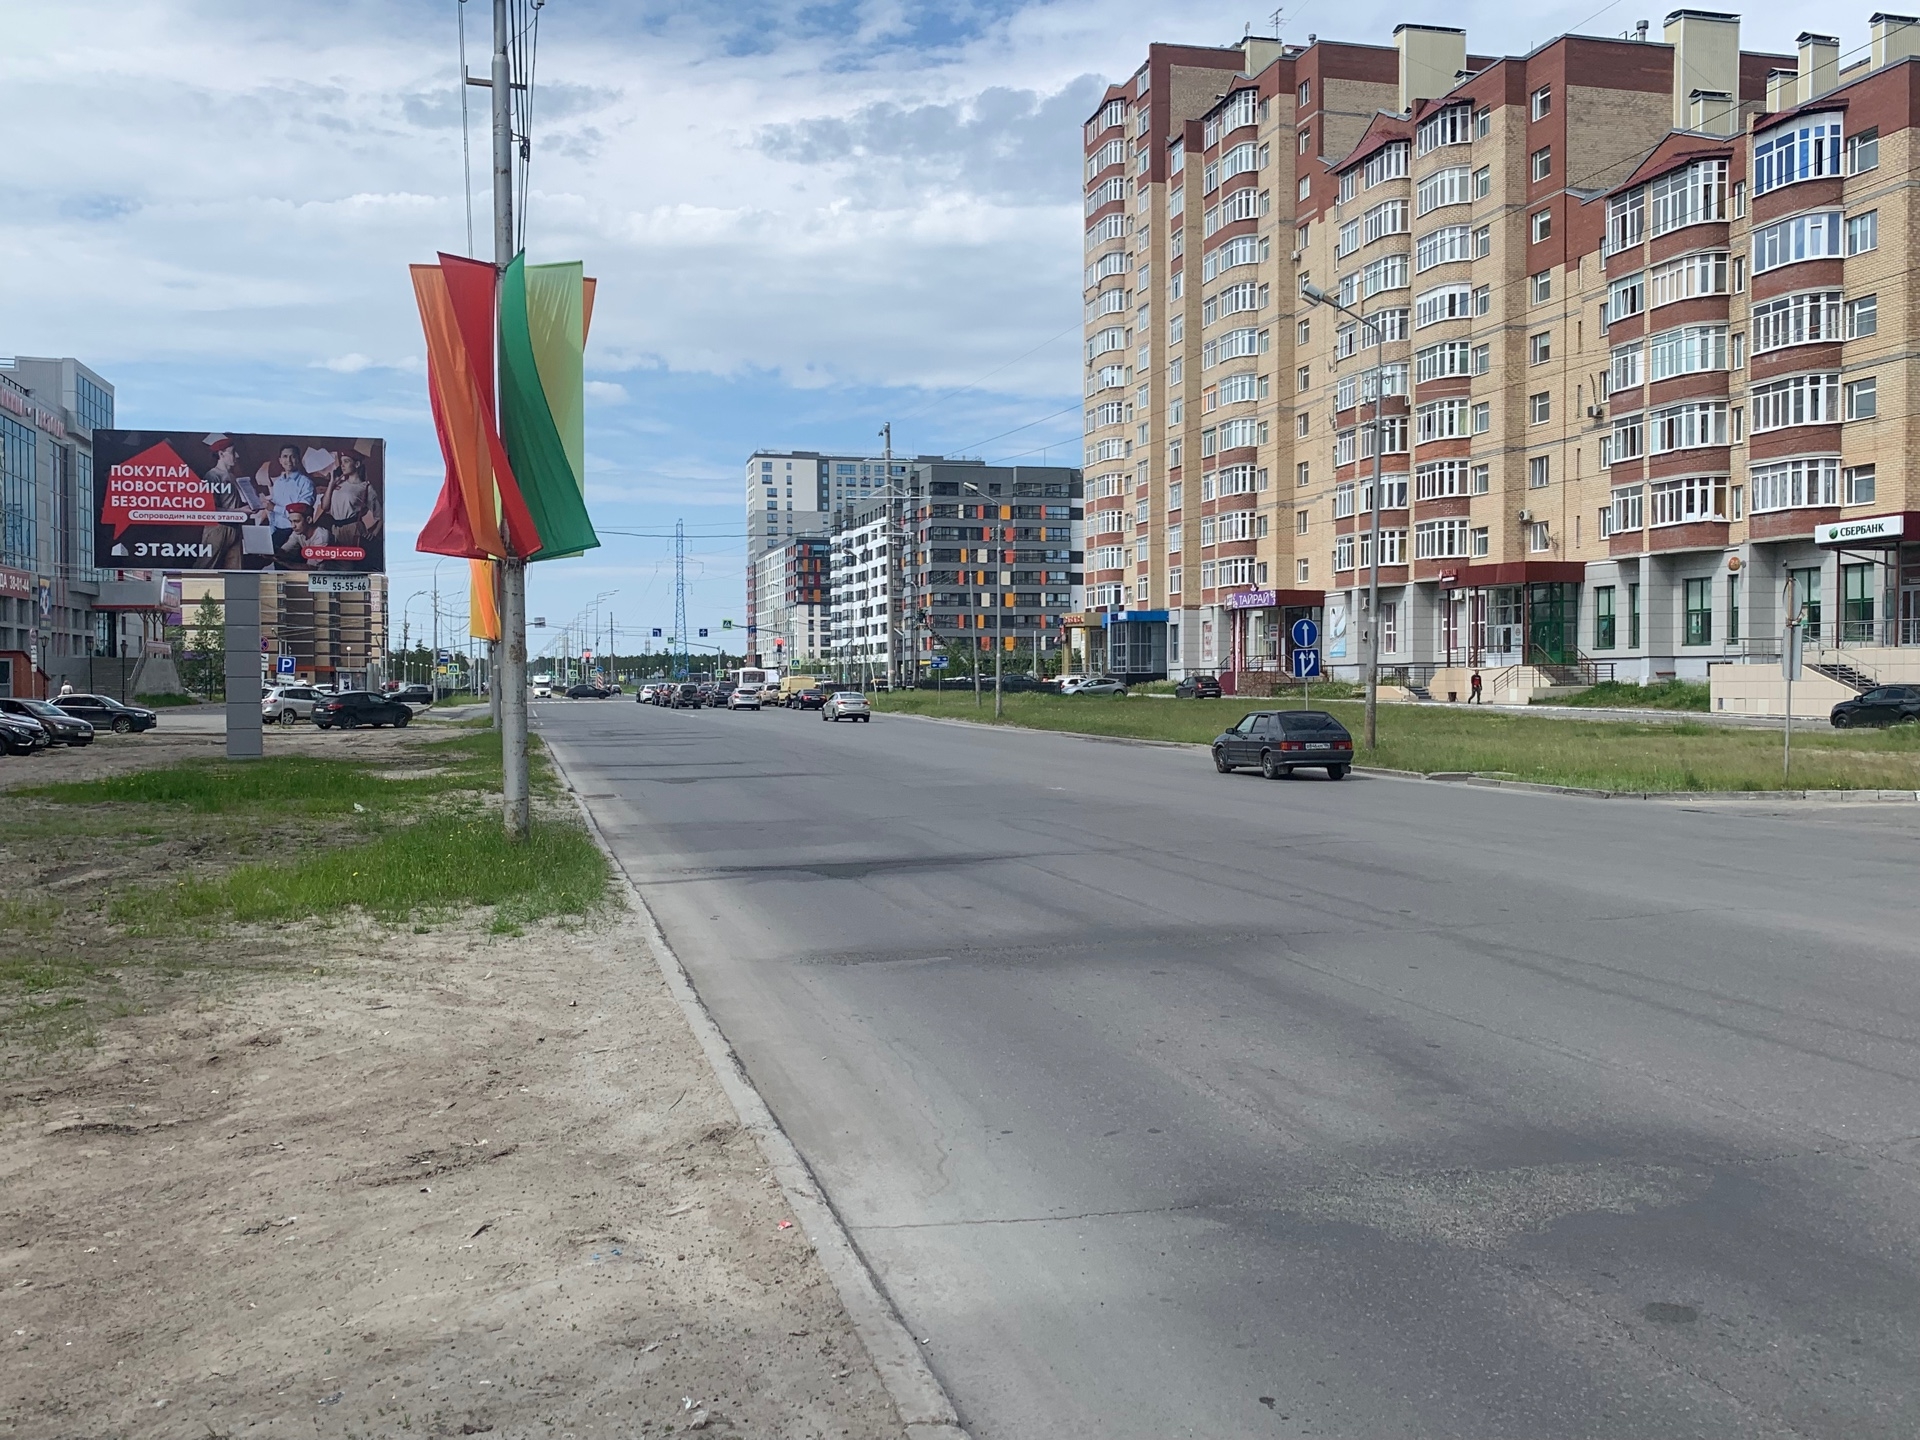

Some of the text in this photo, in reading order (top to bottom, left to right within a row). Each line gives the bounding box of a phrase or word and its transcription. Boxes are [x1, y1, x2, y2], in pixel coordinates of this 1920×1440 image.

[110, 464, 190, 478] ПОКУПАЙ
[111, 480, 231, 494] НОВОСТРОЙКИ
[111, 495, 205, 508] БЕЗОПАСНО
[132, 511, 185, 520] Сопроводим
[1840, 523, 1884, 537] СБЕРБАНК
[315, 548, 363, 559] etagi.com
[332, 582, 367, 591] 55-55-66
[1238, 592, 1270, 605] ТАЙРАЙ
